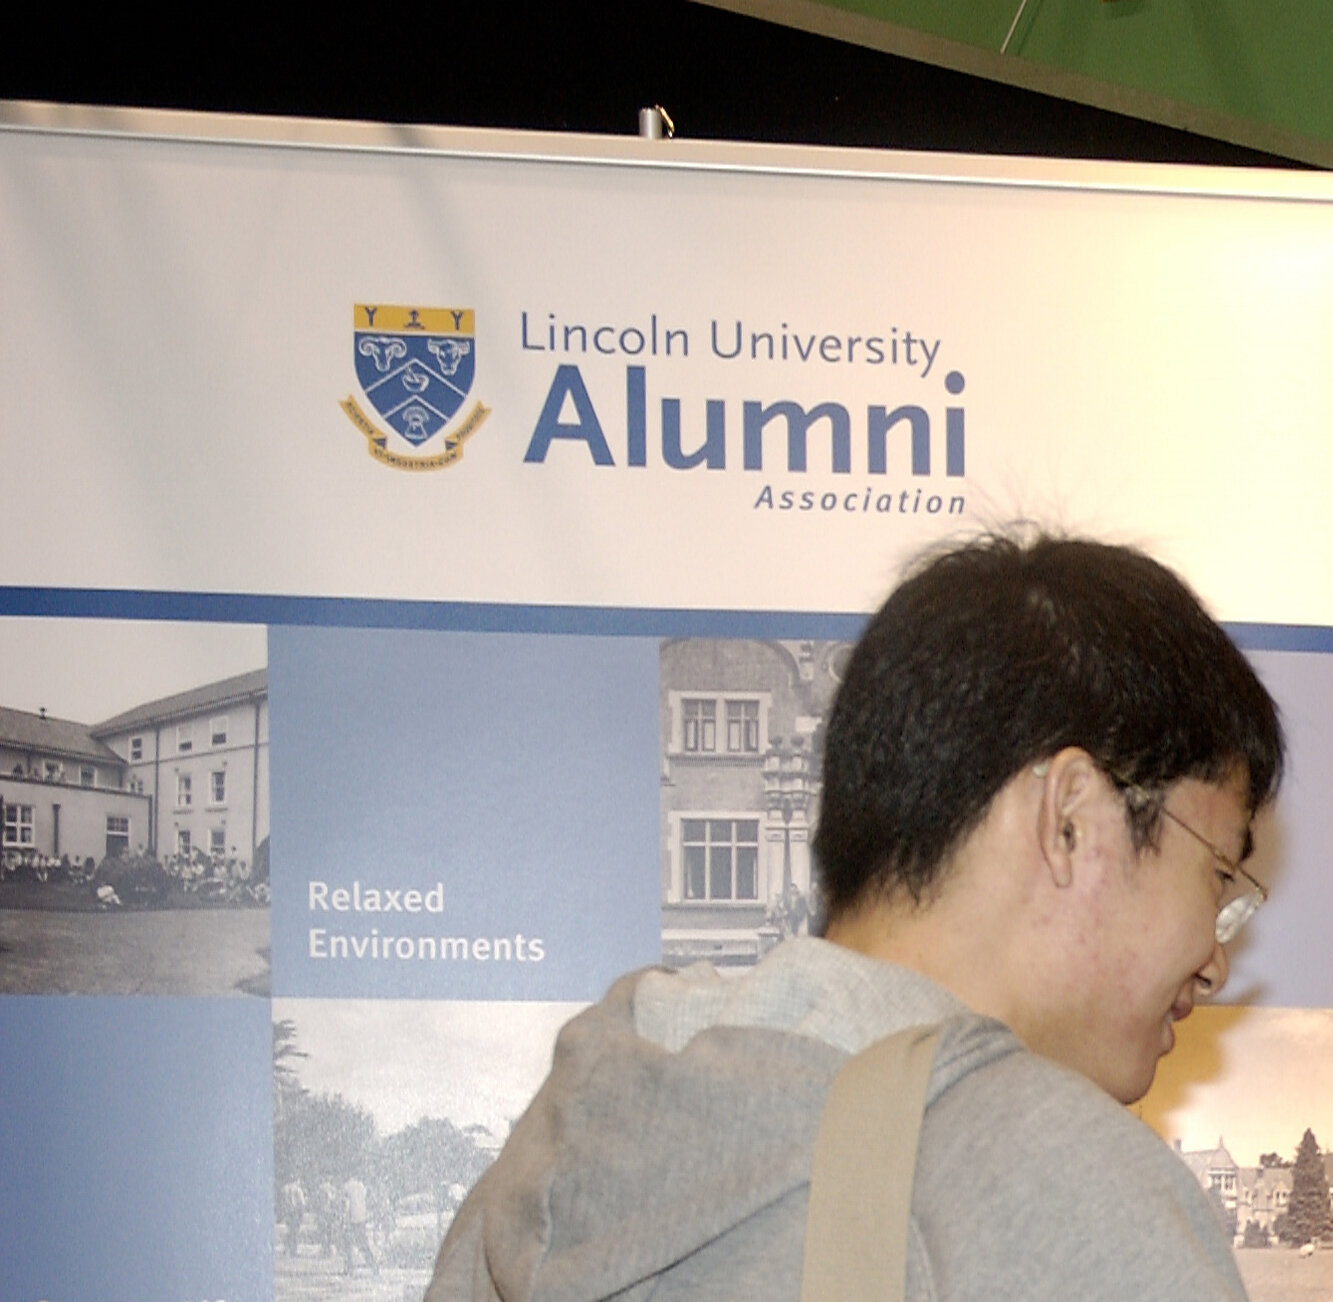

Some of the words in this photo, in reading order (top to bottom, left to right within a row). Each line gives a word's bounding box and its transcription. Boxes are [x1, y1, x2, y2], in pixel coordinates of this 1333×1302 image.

[521, 311, 689, 357] Lincoln
[710, 319, 942, 379] University
[523, 364, 966, 478] Alumni
[753, 484, 966, 515] Association
[307, 880, 444, 913] Relaxed
[308, 928, 547, 962] Environments
